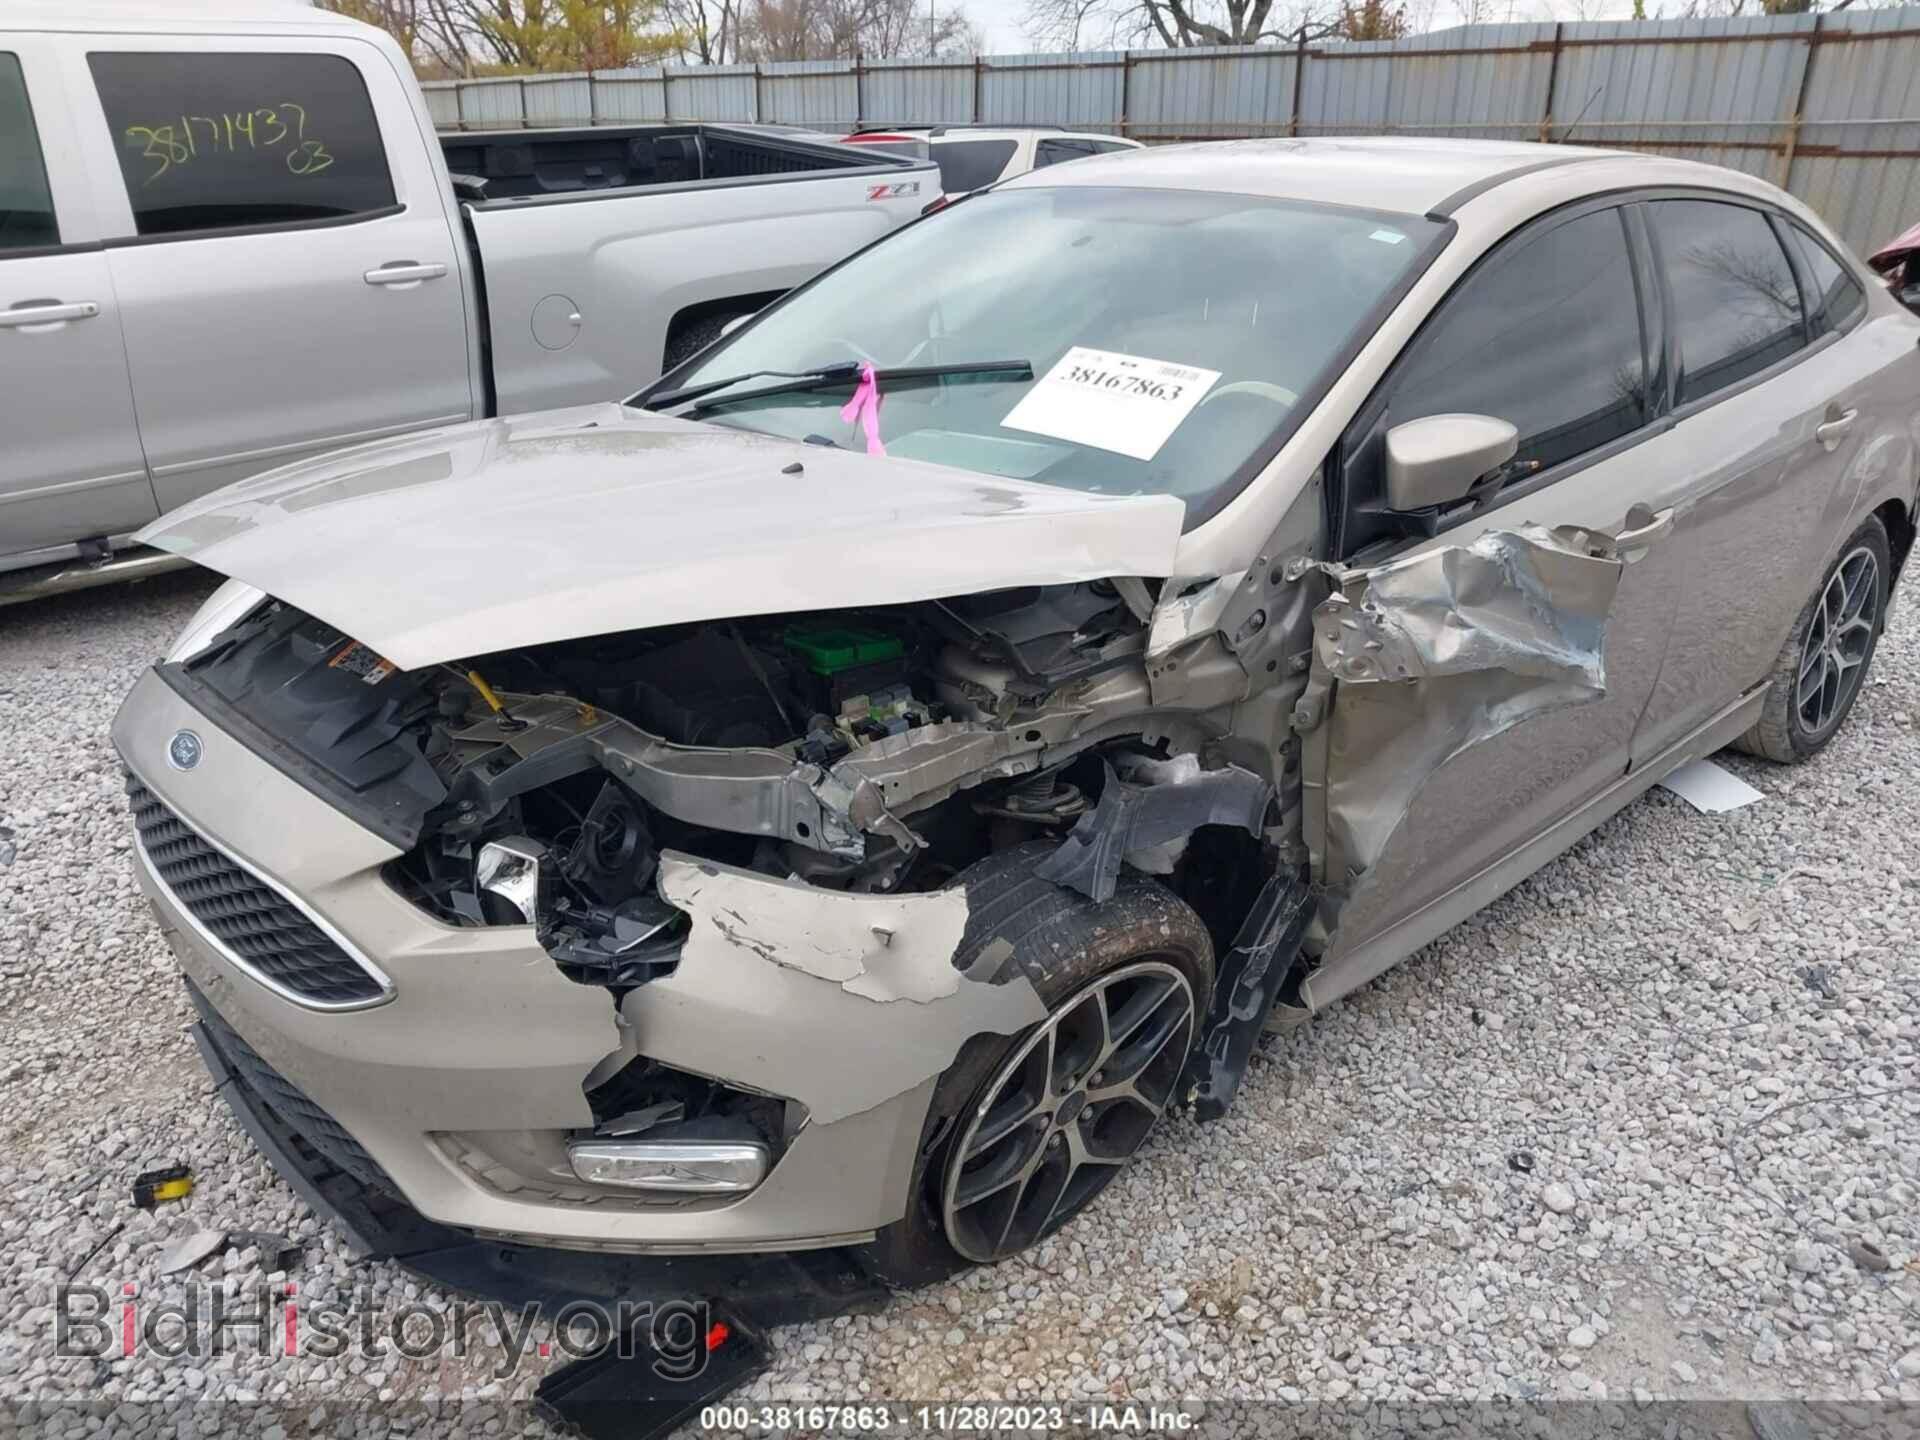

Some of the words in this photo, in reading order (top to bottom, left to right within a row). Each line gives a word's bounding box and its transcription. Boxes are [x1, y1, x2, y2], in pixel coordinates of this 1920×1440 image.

[126, 103, 305, 186] 38171437
[868, 182, 920, 199] Z71
[1061, 365, 1183, 401] 38167863
